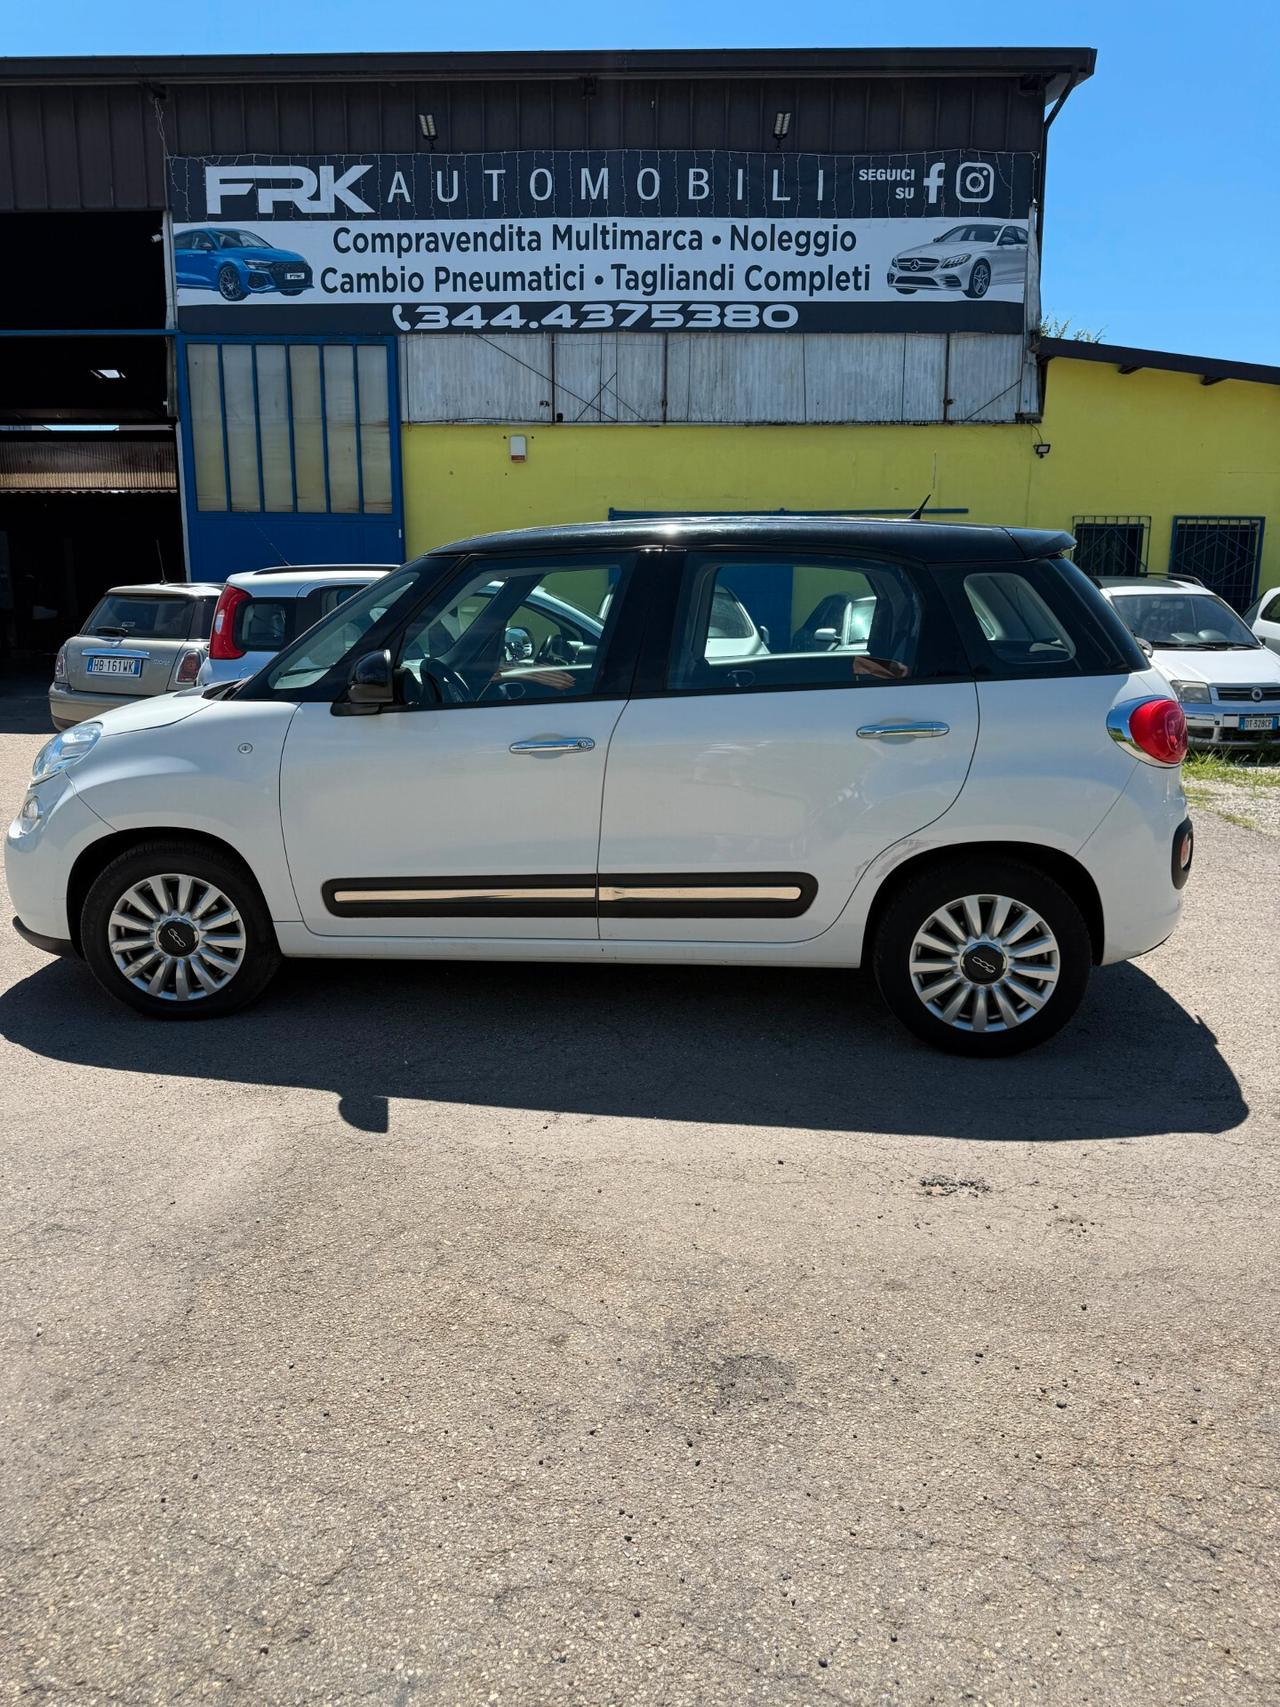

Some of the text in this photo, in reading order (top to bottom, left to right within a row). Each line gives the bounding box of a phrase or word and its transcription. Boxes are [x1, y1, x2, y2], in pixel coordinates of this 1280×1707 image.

[858, 168, 915, 181] SEGUICI
[205, 165, 824, 214] FRK AUTOMOBILI
[895, 187, 915, 199] SU
[333, 222, 857, 258] Compravendita Multimarca Noleggio
[320, 263, 870, 296] Cambio Pneumatici Tagliandi Completi
[414, 303, 799, 329] 344.4375380
